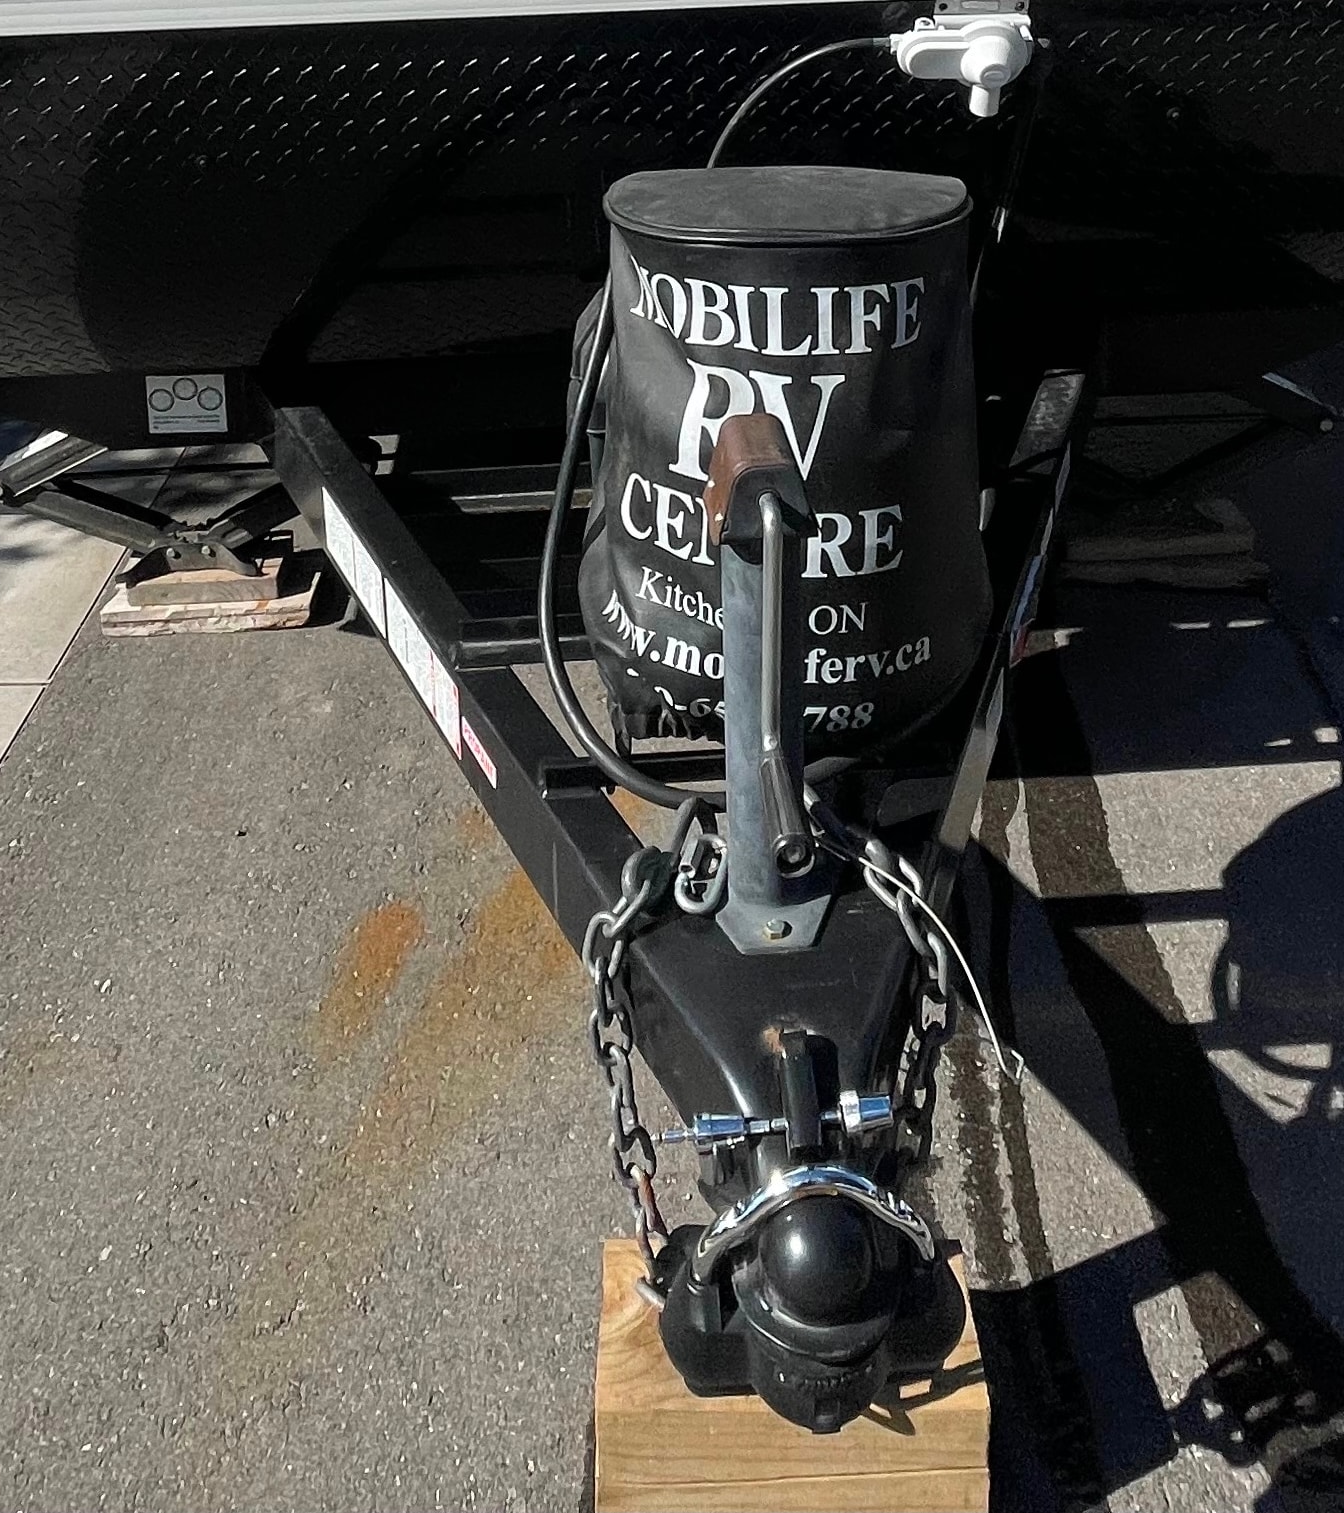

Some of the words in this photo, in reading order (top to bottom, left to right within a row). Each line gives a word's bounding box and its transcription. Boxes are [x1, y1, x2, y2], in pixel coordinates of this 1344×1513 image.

[669, 358, 846, 481] RV
[620, 473, 904, 578] CERE
[808, 602, 868, 635] ON
